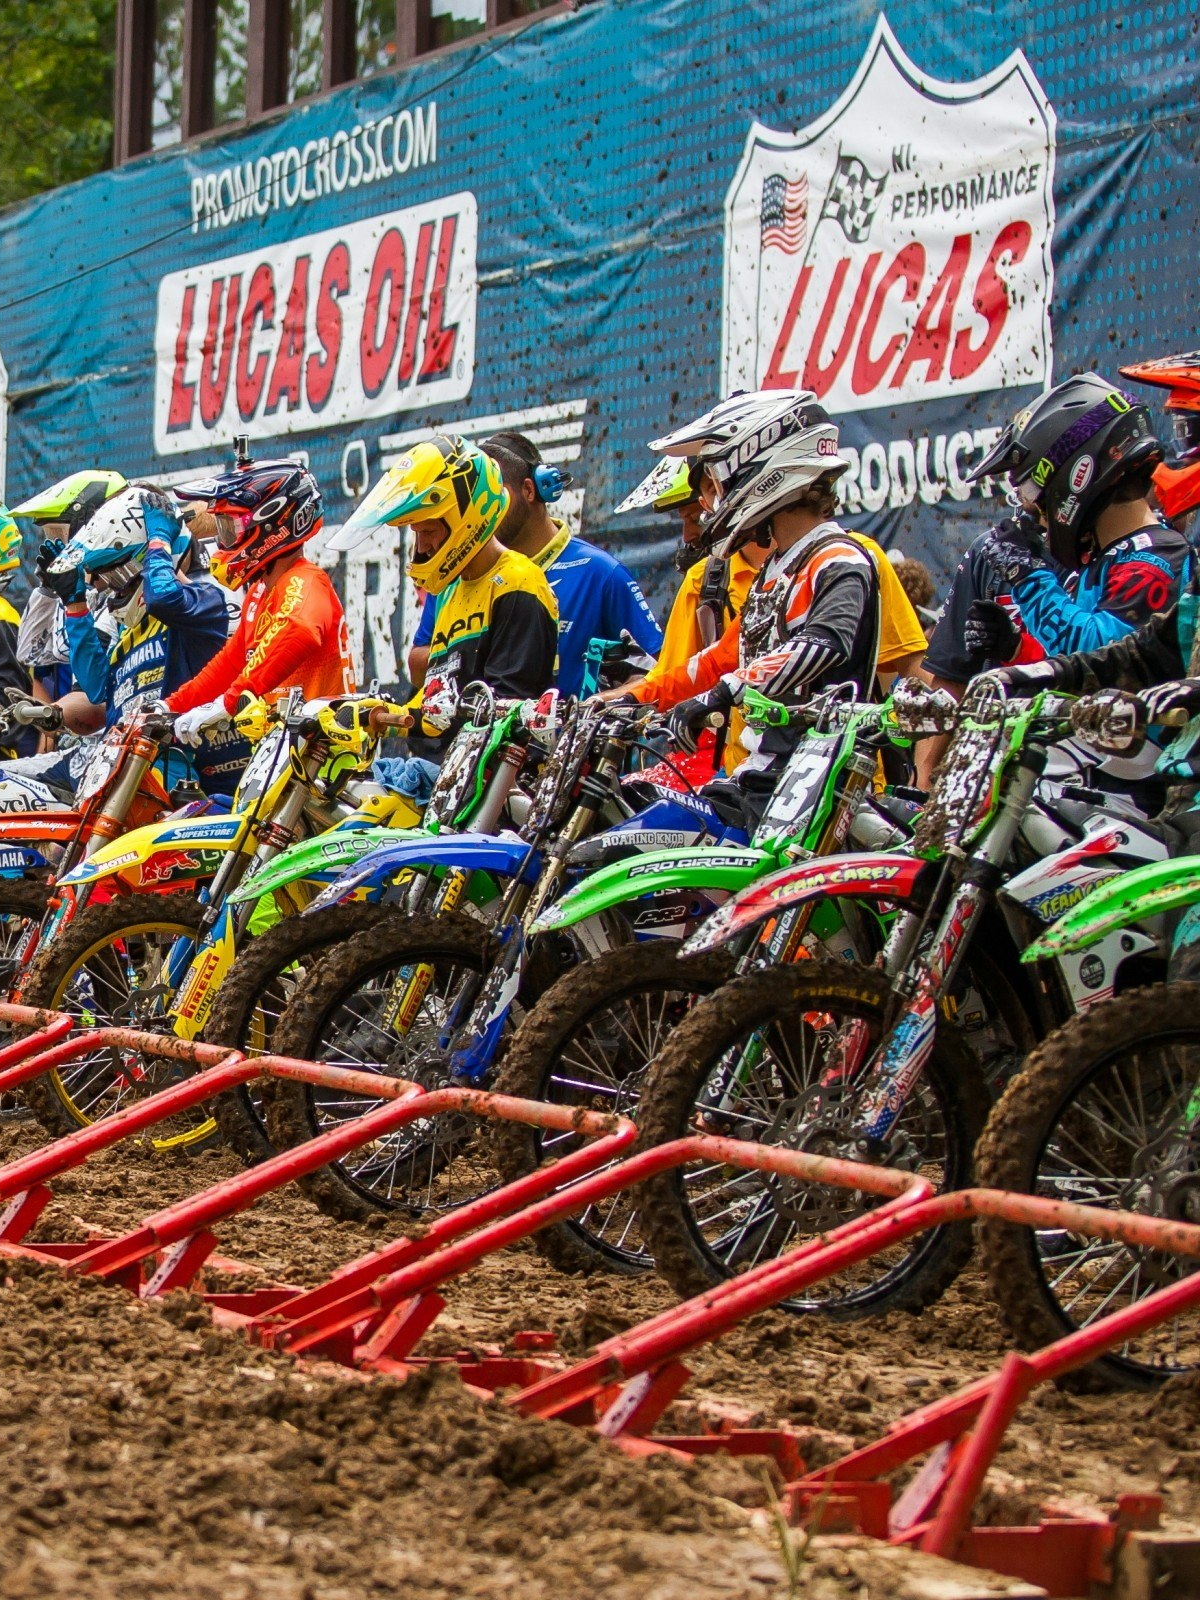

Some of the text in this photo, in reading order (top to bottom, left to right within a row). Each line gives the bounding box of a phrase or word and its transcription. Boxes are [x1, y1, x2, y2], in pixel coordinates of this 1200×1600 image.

[191, 101, 438, 234] PROMOTOCROSS.COM
[890, 163, 1041, 222] PERFORMANCE
[166, 214, 461, 435] LUCAS OIL
[761, 220, 1032, 400] LUCAS
[726, 408, 808, 475] 100%
[757, 471, 784, 498] SHOEI
[834, 427, 1014, 517] RODUCT
[1073, 461, 1090, 488] BELL
[123, 640, 166, 678] YAMAHA
[209, 729, 244, 748] AMAH
[215, 757, 251, 773] ROOS
[660, 788, 713, 816] YAMAHA
[767, 753, 831, 822] 3
[171, 826, 235, 841] SUPERSTORE!
[321, 836, 413, 863] prove
[601, 832, 656, 849] ROARING
[656, 832, 684, 845] KNOB
[99, 852, 139, 874] MOTUL
[628, 857, 758, 878] PRO CIRCUIT
[769, 865, 901, 900] TEAM CAREY
[1038, 888, 1085, 920] TEAM
[181, 953, 220, 1020] PIRELLI
